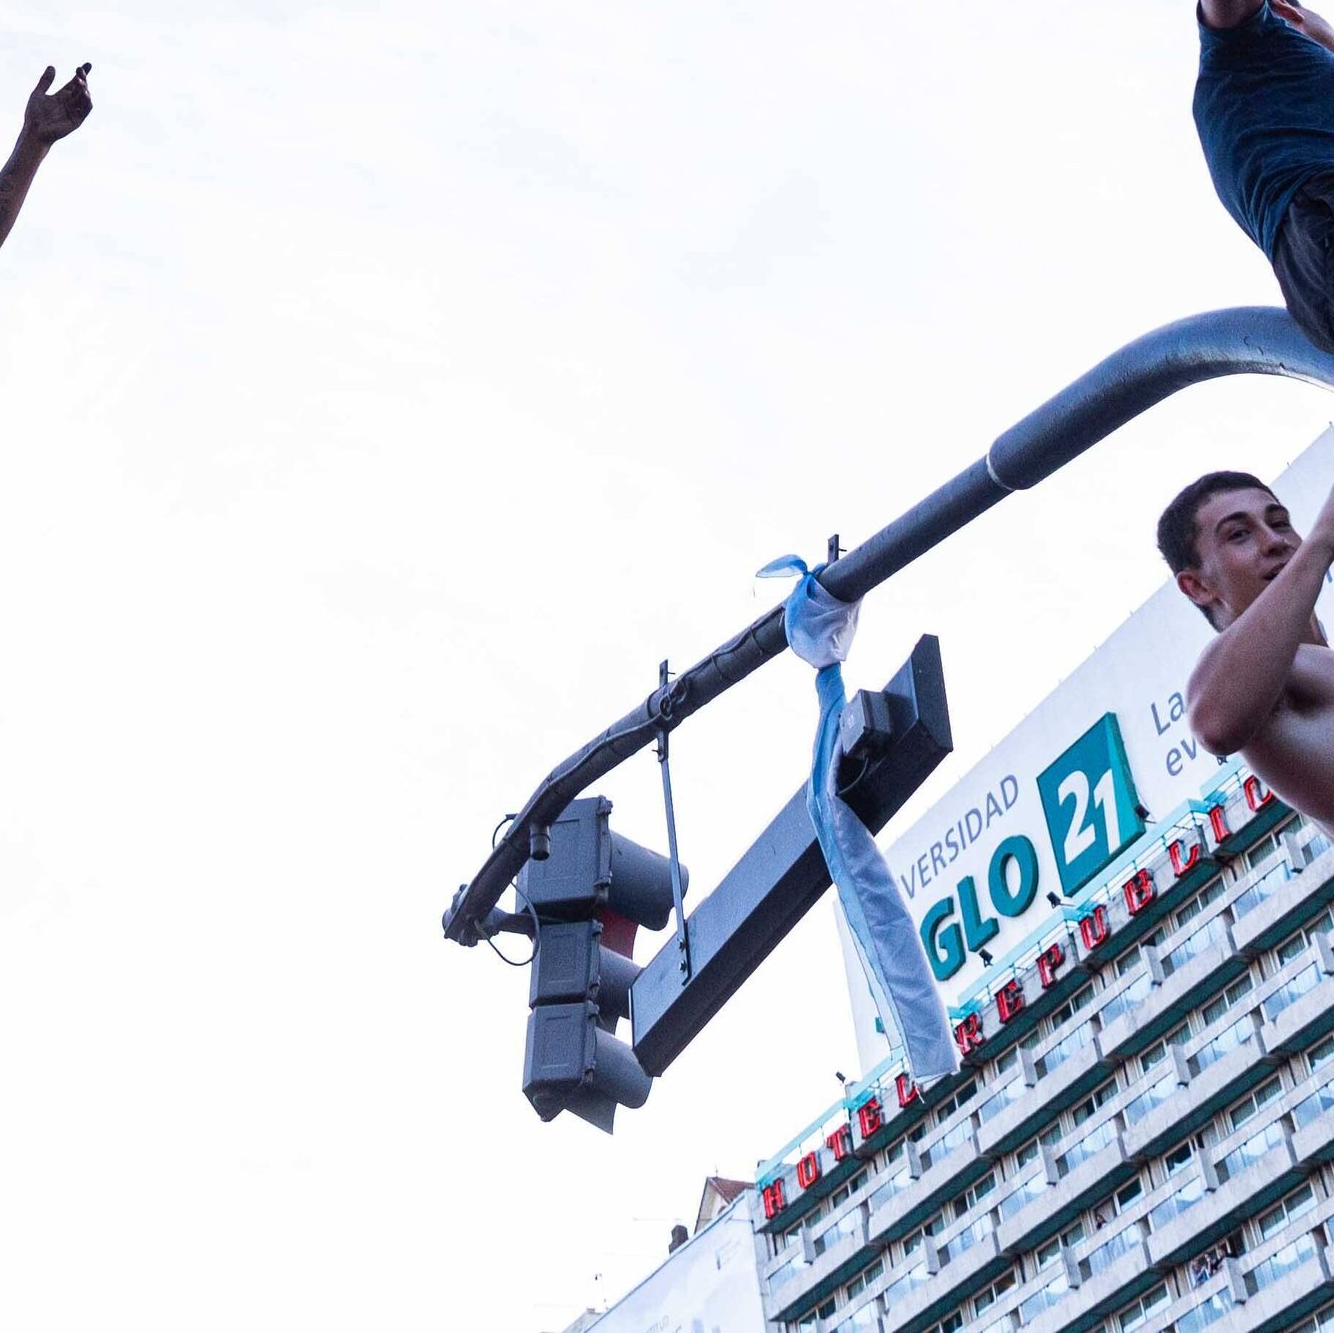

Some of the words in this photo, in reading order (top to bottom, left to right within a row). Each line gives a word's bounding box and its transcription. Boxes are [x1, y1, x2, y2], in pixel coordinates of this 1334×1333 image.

[898, 774, 1020, 900] VERSIDAD
[1058, 768, 1122, 865] 21
[920, 834, 1040, 982] GLO
[762, 1072, 923, 1219] HOTEL
[954, 774, 1275, 1055] REPUBLIC
